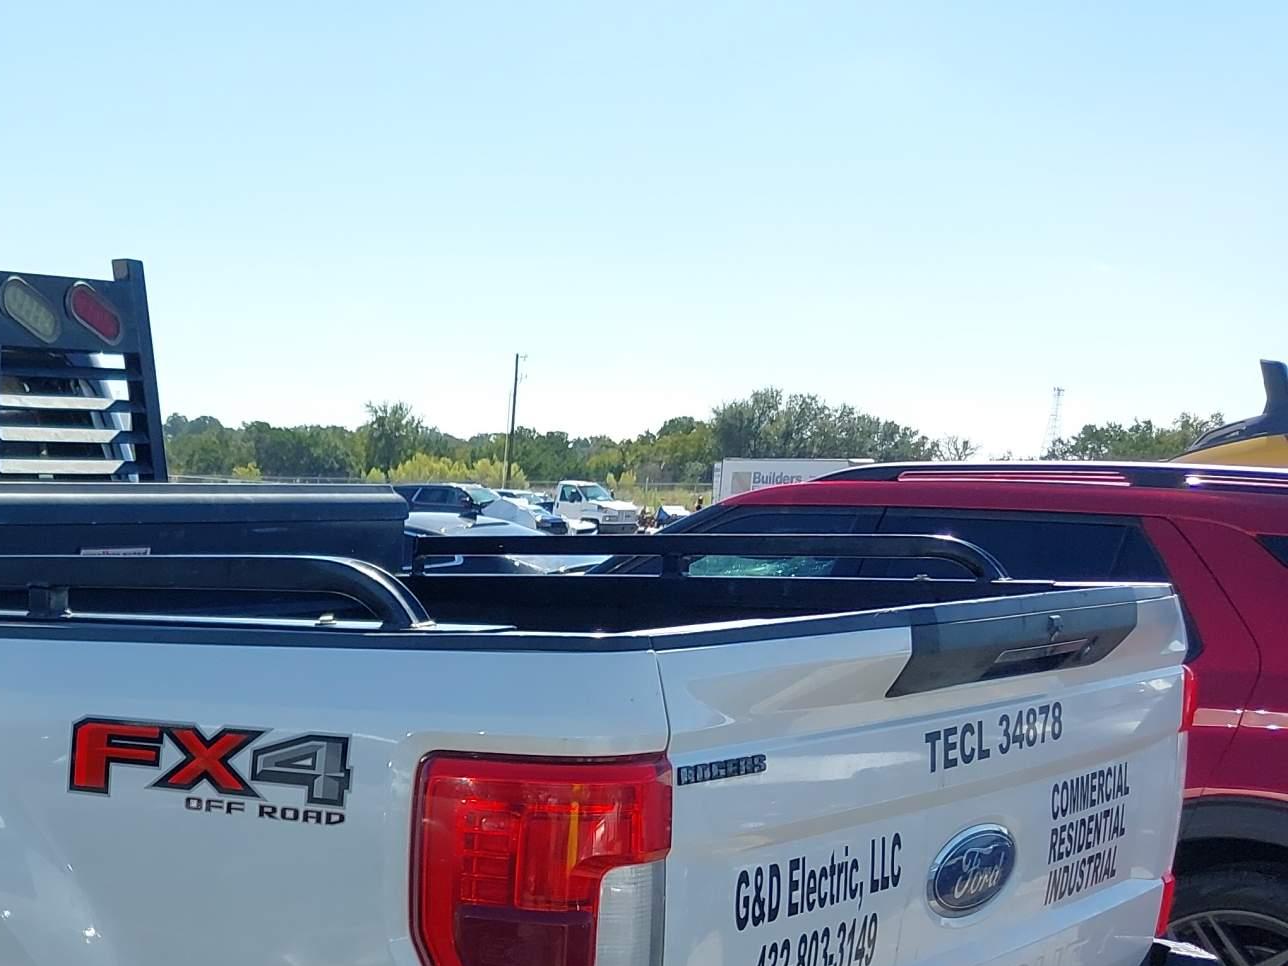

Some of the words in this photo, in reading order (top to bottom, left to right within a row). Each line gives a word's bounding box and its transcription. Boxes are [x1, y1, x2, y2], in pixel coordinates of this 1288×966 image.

[753, 471, 803, 485] Builders
[66, 714, 354, 809] FX4
[925, 720, 991, 774] TECL
[998, 701, 1063, 755] 34878
[185, 797, 245, 815] OFF
[258, 804, 346, 826] ROAD
[1051, 761, 1130, 821] COMMERCIAL
[1047, 802, 1126, 866] RESIDENTIAL
[735, 862, 781, 932] G&D
[787, 845, 864, 918] Electric,
[870, 832, 902, 894] LLC
[953, 846, 1006, 899] Ford
[1043, 845, 1118, 906] INDUSTRIAL
